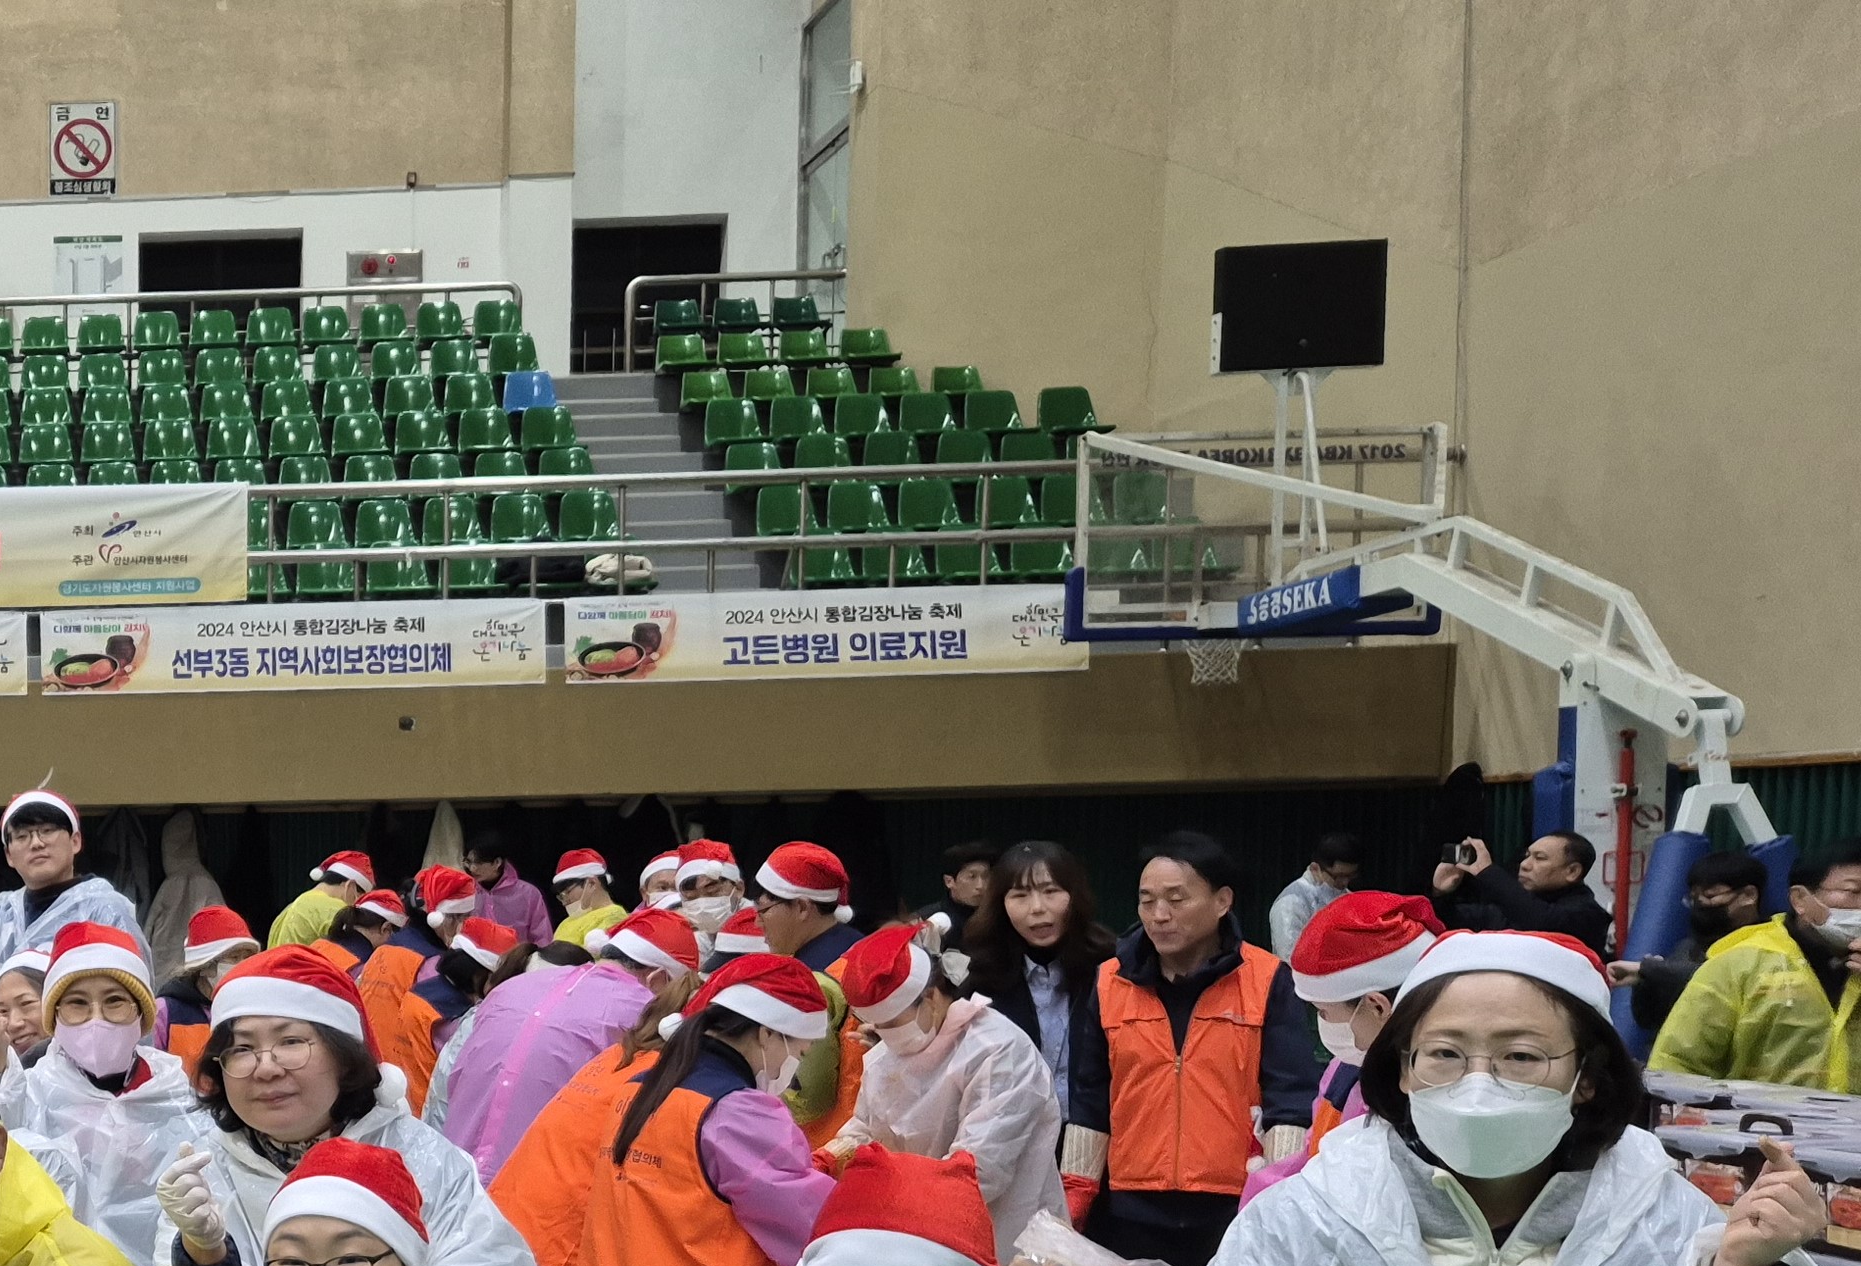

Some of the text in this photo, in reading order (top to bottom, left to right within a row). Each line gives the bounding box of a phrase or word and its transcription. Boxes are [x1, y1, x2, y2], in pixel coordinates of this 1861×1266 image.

[72, 524, 94, 537] 주최
[72, 554, 94, 567] 주관
[725, 603, 963, 626] 2024 안산시 통합김장나눔 축제
[197, 616, 426, 638] 2024 안산시 통합김장나눔 축제
[722, 629, 968, 666] 고든병원 의료지원
[172, 642, 452, 680] 선부3동 지역사회보장협의체
